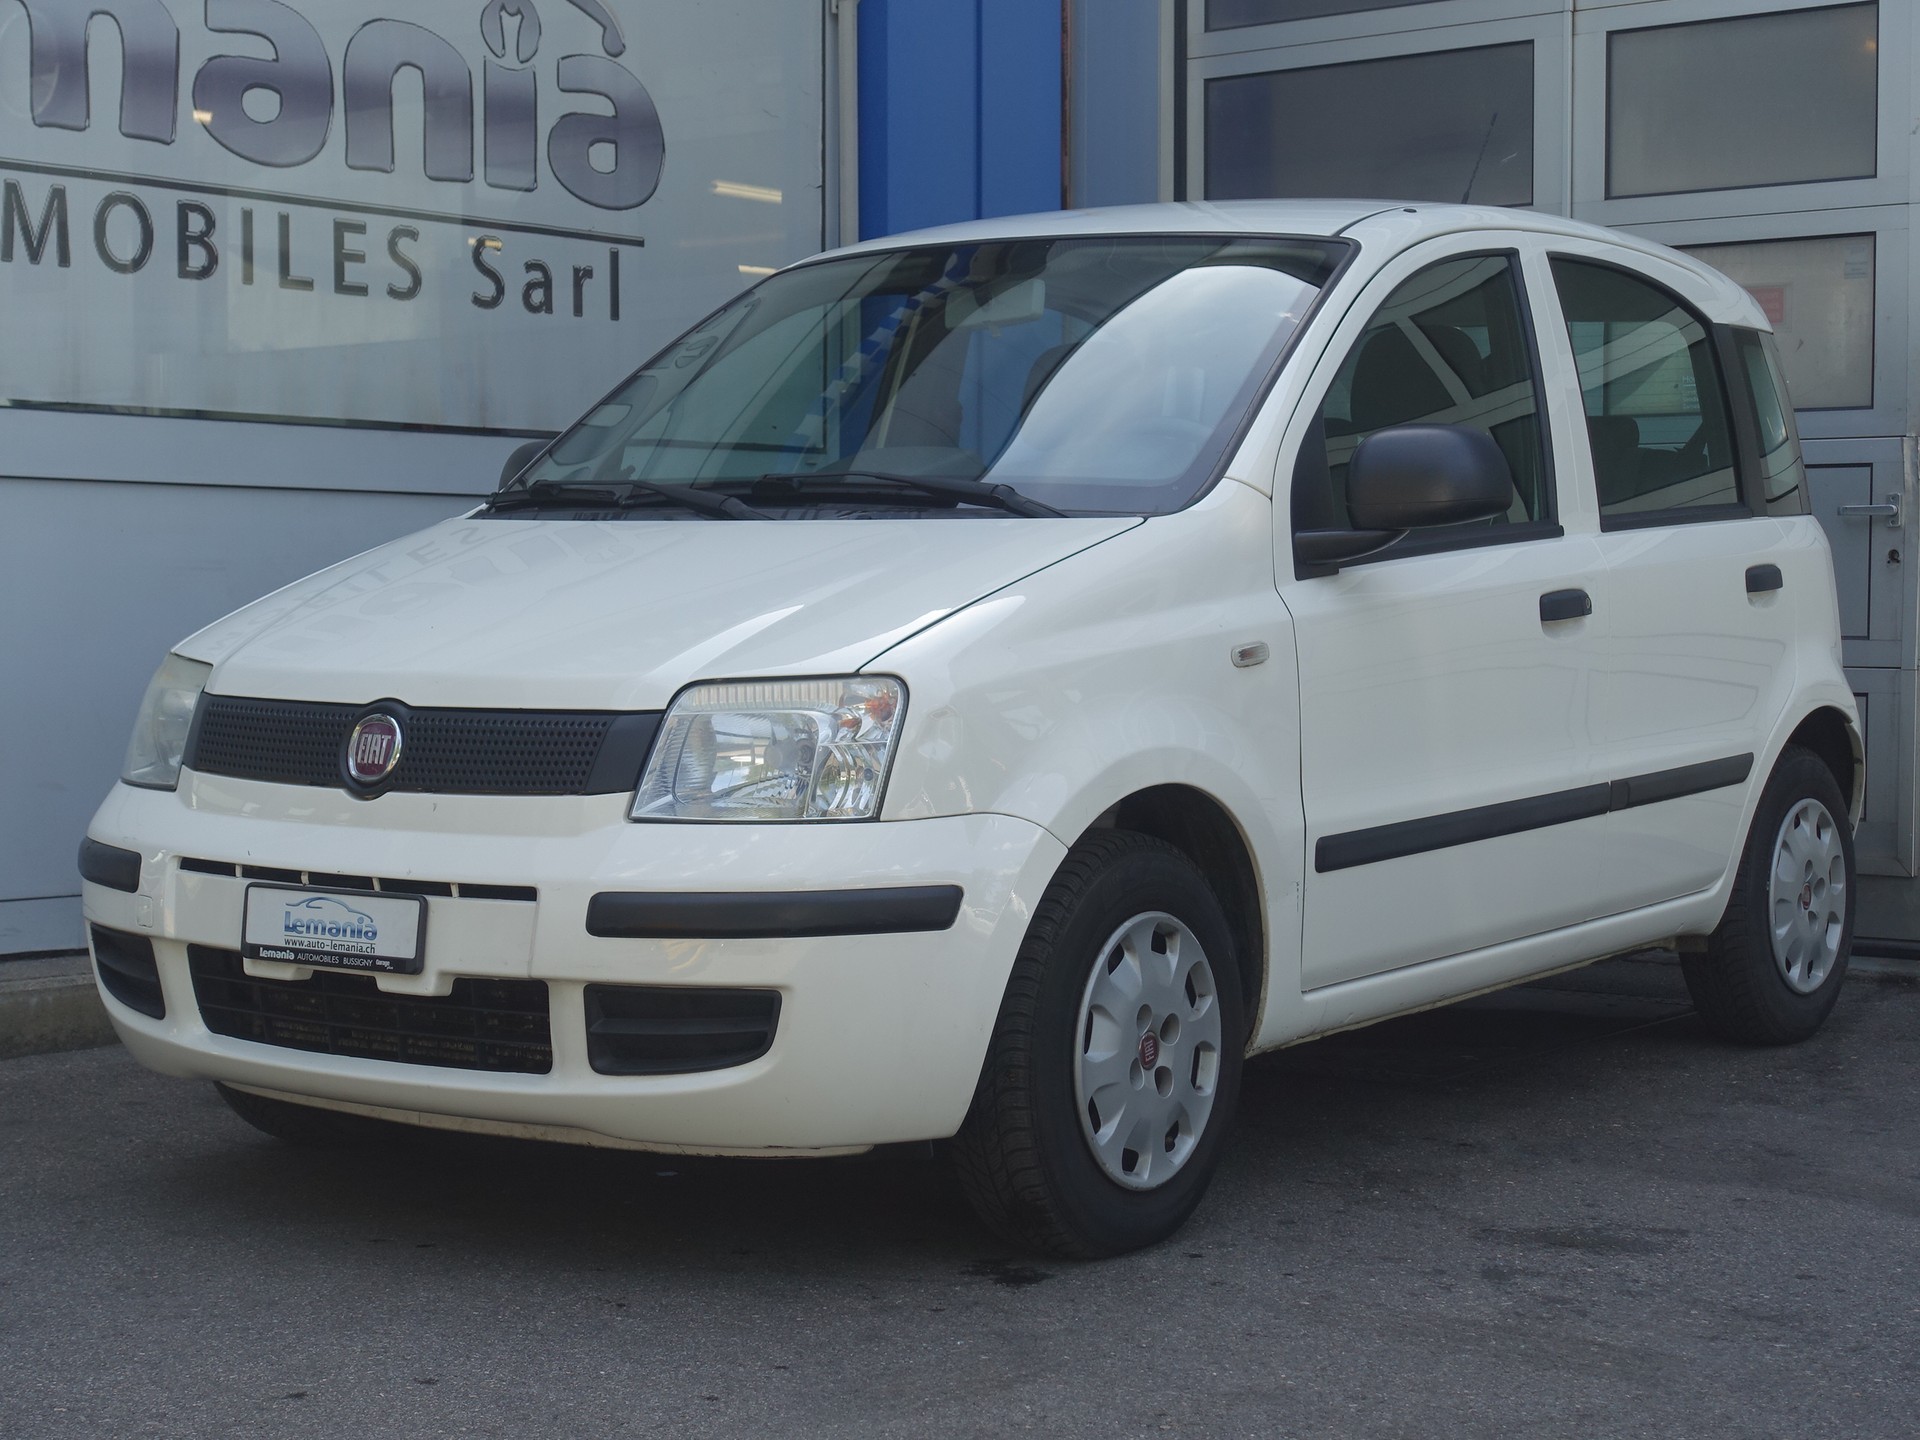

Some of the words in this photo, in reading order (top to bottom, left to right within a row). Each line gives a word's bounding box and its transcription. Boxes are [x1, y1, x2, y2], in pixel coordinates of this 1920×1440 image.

[0, 178, 422, 300] MOBILES
[471, 235, 620, 321] Sarl
[357, 733, 392, 765] FIAT
[284, 910, 378, 941] Lemania
[259, 946, 295, 960] Lemania
[296, 952, 340, 965] AUTOMOBILES
[342, 956, 373, 967] BUSSIGNY
[284, 938, 376, 954] www.auto-lemania.ch
